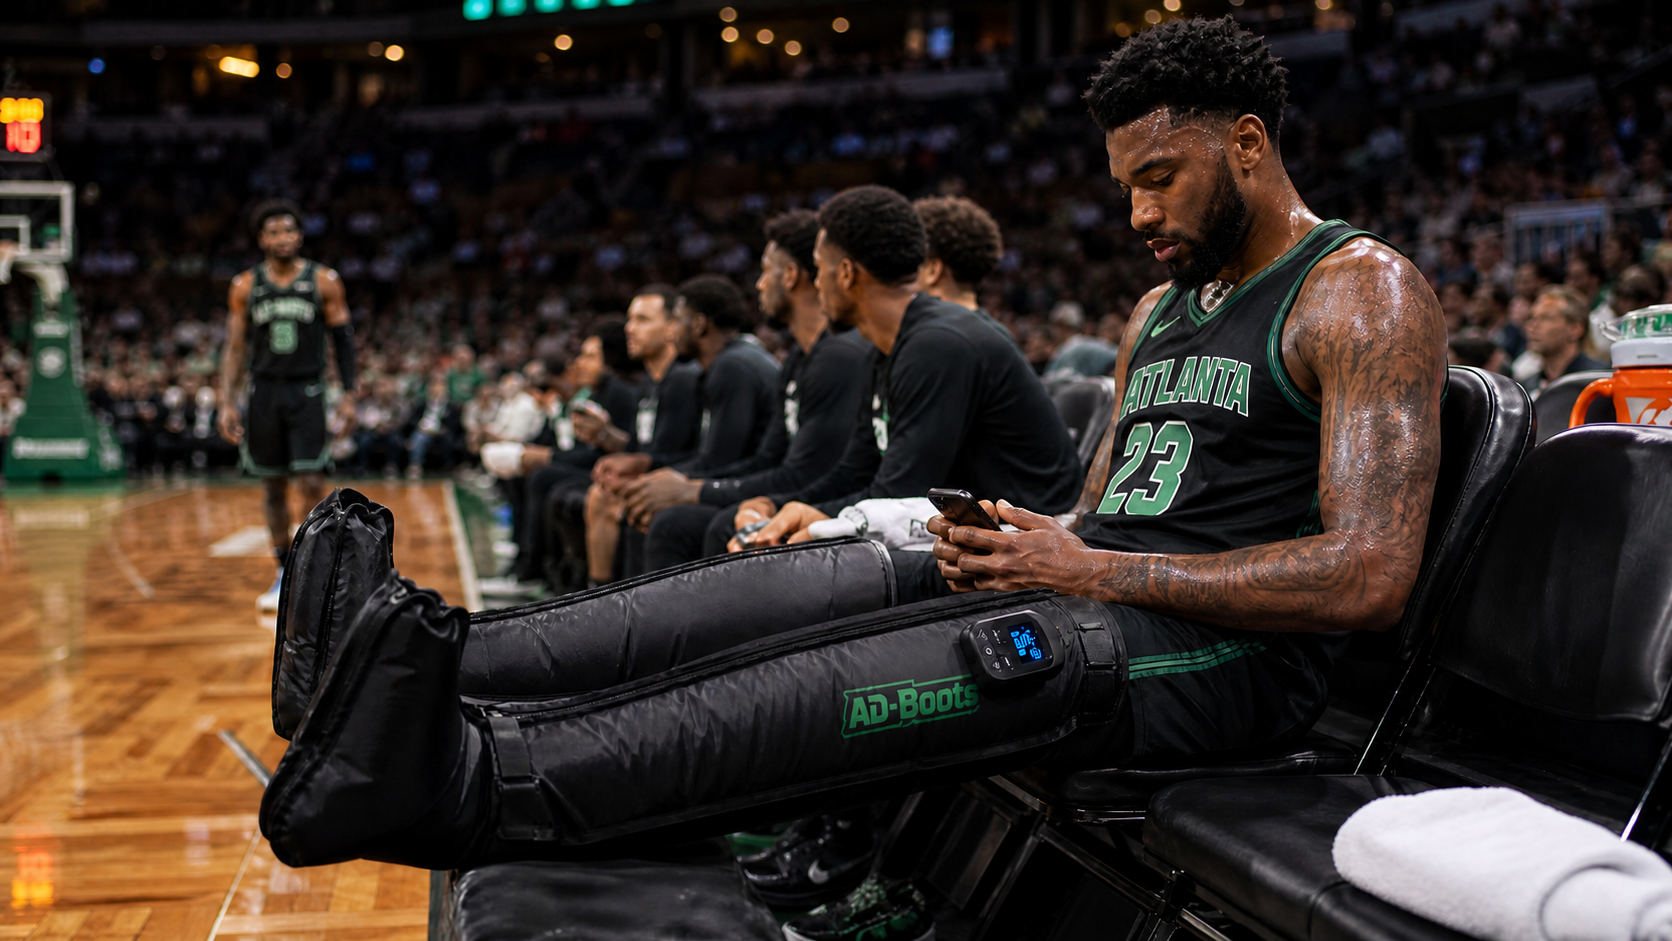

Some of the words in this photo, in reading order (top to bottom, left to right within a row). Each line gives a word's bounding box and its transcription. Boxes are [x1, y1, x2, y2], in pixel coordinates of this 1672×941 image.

[1119, 356, 1251, 421] ATLANTA
[1096, 420, 1193, 516] 23
[849, 682, 979, 729] AD-Boots
